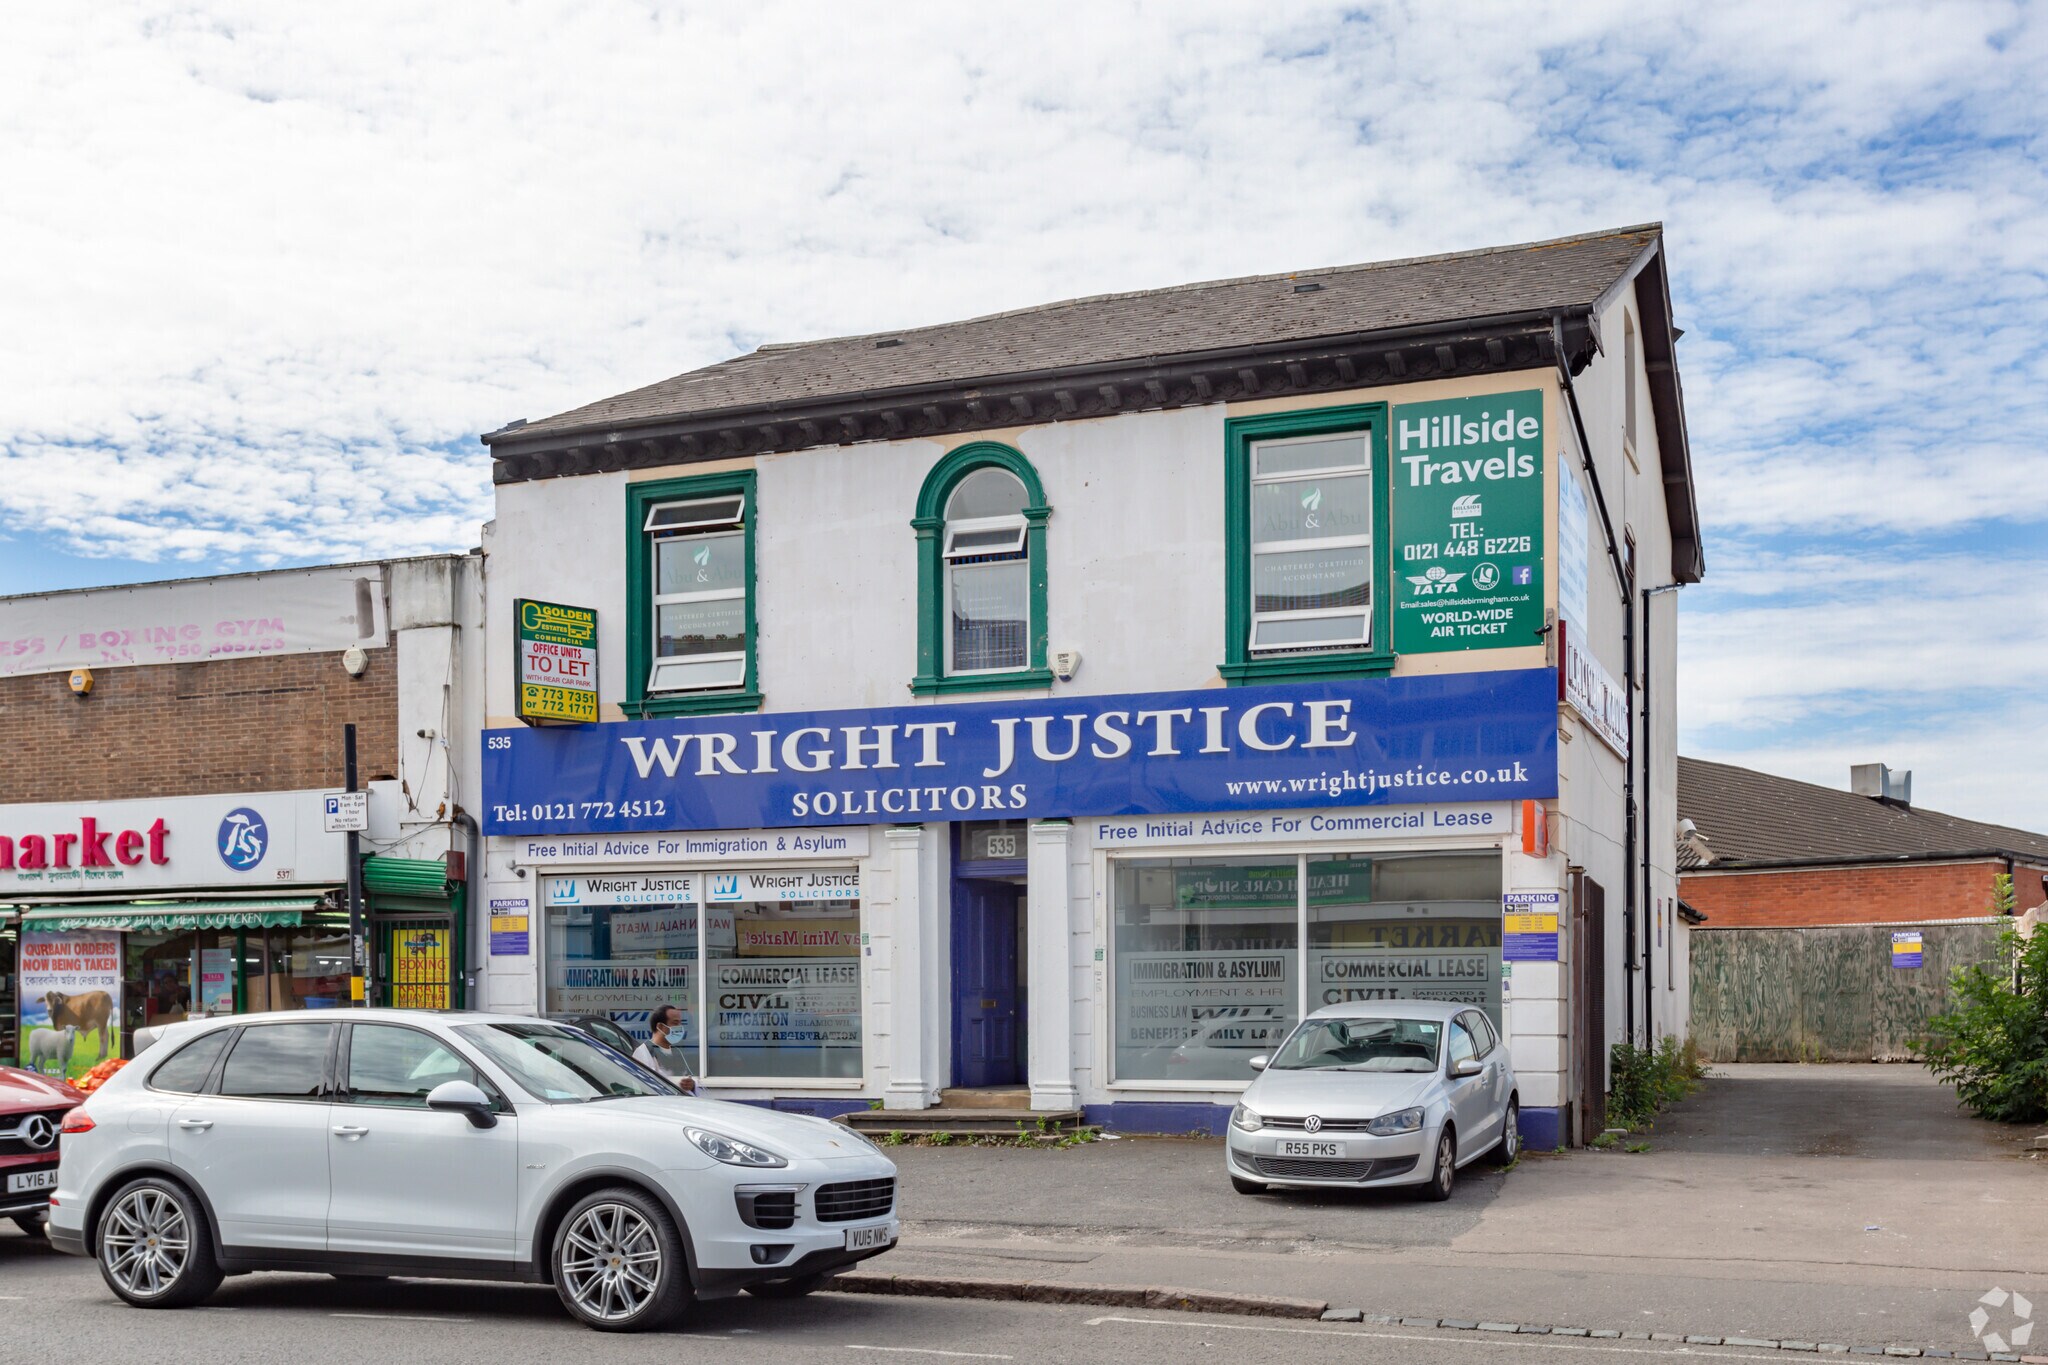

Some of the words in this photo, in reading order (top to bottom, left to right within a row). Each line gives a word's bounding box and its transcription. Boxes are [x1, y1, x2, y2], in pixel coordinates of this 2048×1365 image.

[1399, 408, 1539, 451] Hillside
[1401, 447, 1535, 487] Travels
[1262, 513, 1300, 533] Abu
[1305, 513, 1320, 529] &
[1323, 508, 1362, 528] Abu
[1449, 521, 1484, 539] TEL:
[1404, 542, 1439, 561] 0121
[1443, 540, 1479, 558] 448
[1484, 536, 1531, 555] 6226
[1264, 562, 1315, 573] CHARTERED
[1318, 558, 1365, 569] CERTIFIED
[696, 568, 709, 583] &
[1282, 571, 1346, 583] ACCOUNTANTS
[1413, 583, 1459, 596] IATA
[1400, 593, 1530, 609] Email:sales@hillsidebirmingham.co.uk
[542, 606, 592, 622] GOLDEN
[1421, 607, 1514, 625] WORLD-WIDE
[79, 623, 202, 650] BOXING
[215, 617, 286, 637] GYM
[541, 623, 568, 633] ESTATES
[1430, 625, 1455, 638] AIR
[1457, 622, 1508, 636] TICKET
[534, 633, 583, 646] COMMERCIAL
[532, 642, 559, 656] OFFICE
[560, 646, 582, 660] UNITS
[527, 654, 552, 673] TO
[558, 658, 590, 677] LET
[525, 673, 542, 681] WITH
[543, 675, 561, 683] REAR
[561, 677, 575, 685] CAR
[575, 679, 591, 688] PARK
[541, 687, 564, 700] 773
[567, 691, 595, 704] 7351
[525, 700, 537, 709] or
[541, 699, 564, 712] 772
[568, 702, 594, 716] 1717
[487, 736, 512, 750] 535
[620, 719, 956, 779] WRIGHT
[983, 698, 1358, 778] JUSTICE
[1225, 761, 1528, 798] www.wrightjustice.co.uk
[328, 799, 337, 813] P
[791, 782, 1028, 818] SOLICITORS
[493, 803, 528, 822] Tel:
[531, 802, 578, 821] 0121
[579, 801, 616, 820] 772
[618, 798, 667, 819] 4512
[1099, 824, 1138, 841] Free
[1145, 820, 1193, 838] Initial
[1200, 819, 1263, 836] Advice
[1271, 817, 1302, 834] For
[1310, 811, 1426, 833] Commercial
[1433, 809, 1493, 827] Lease
[527, 842, 557, 858] Free
[562, 841, 599, 857] Initial
[603, 840, 650, 856] Advice
[657, 840, 681, 855] For
[685, 837, 768, 856] Immigration
[775, 837, 787, 852] &
[793, 835, 847, 854] Asylum
[990, 837, 1014, 855] 535
[276, 870, 290, 880] 537
[616, 893, 691, 903] SOLICITORS
[781, 889, 860, 899] SOLICITORS
[1506, 894, 1556, 903] PARKING
[492, 899, 527, 908] PARKING
[133, 915, 170, 927] HALAL
[172, 913, 200, 926] MEAT
[204, 914, 213, 925] &
[215, 912, 263, 925] CHICKEN
[24, 943, 71, 956] QURBANI
[73, 942, 117, 955] ORDERS
[22, 958, 50, 971] NOW
[51, 958, 82, 971] BEING
[83, 958, 118, 971] TAKEN
[399, 959, 447, 971] BOXING
[1133, 961, 1214, 980] IMMIGRATION
[1217, 961, 1227, 979] &
[1229, 960, 1281, 978] ASYLUM
[1324, 959, 1432, 978] COMMERCIAL
[1438, 958, 1485, 977] LEASE
[631, 968, 640, 987] &
[642, 967, 686, 987] ASYLUM
[815, 967, 855, 984] LEASE
[1131, 988, 1241, 998] EMPLOYMENT
[1244, 988, 1255, 997] &
[1260, 987, 1283, 996] HR
[719, 993, 790, 1010] CIVIL
[719, 1012, 789, 1027] LITIGATION
[1130, 1005, 1170, 1019] BUSINESS
[1170, 1005, 1188, 1019] LAW
[794, 1019, 834, 1027] ISLAMIC
[771, 1031, 858, 1040] REGISTRATION
[1130, 1027, 1188, 1040] BENEFITS
[1285, 1141, 1309, 1155] R55
[1312, 1143, 1337, 1156] PKS
[16, 1174, 45, 1189] LY16
[852, 1229, 872, 1246] VU15
[872, 1226, 888, 1245] NWS
